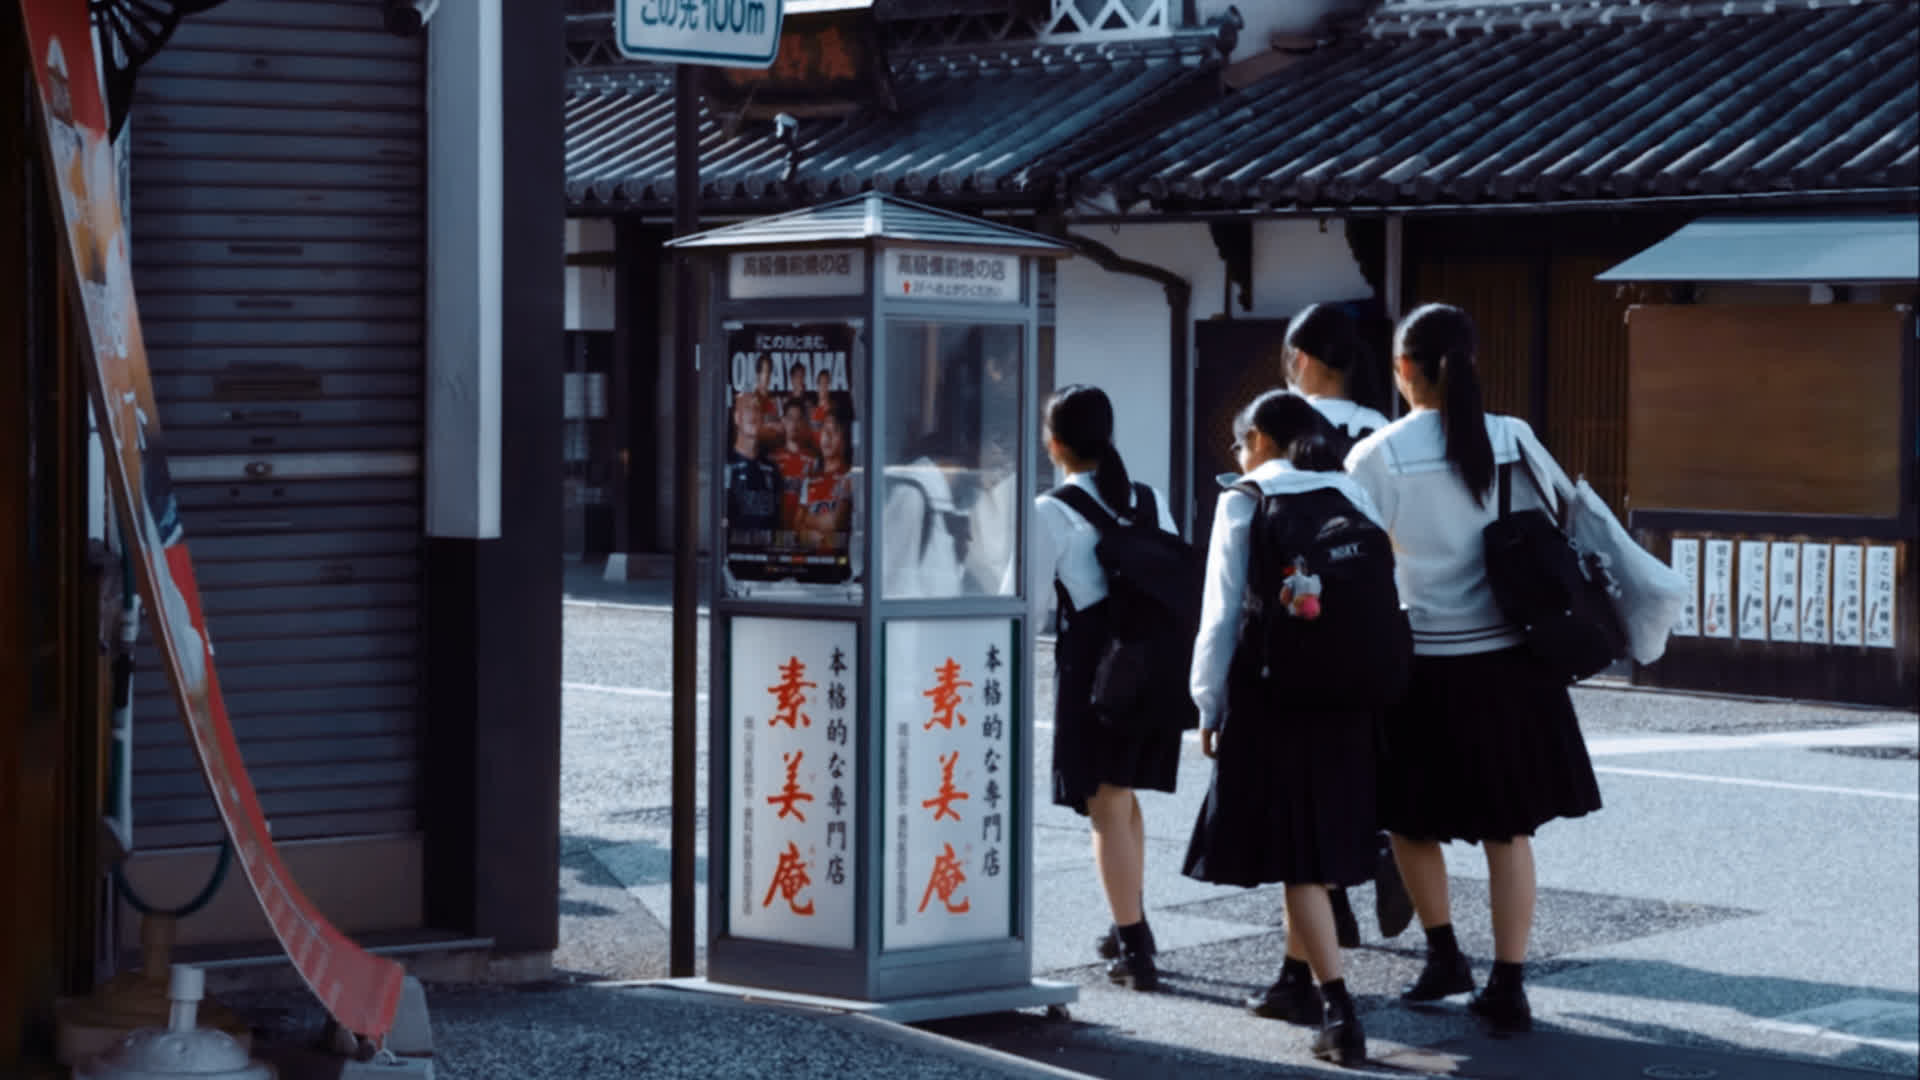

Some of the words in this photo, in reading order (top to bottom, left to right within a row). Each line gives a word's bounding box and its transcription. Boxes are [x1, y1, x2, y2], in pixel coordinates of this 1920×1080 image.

[641, 0, 765, 34] この先100m
[743, 253, 850, 277] 高級備前焼の店
[896, 254, 1006, 281] 高級備前焼の店
[763, 655, 818, 917] 素美庵
[825, 646, 848, 887] 本格的な専門店
[918, 656, 973, 914] 素美庵
[981, 643, 1004, 879] 本格的な専門店
